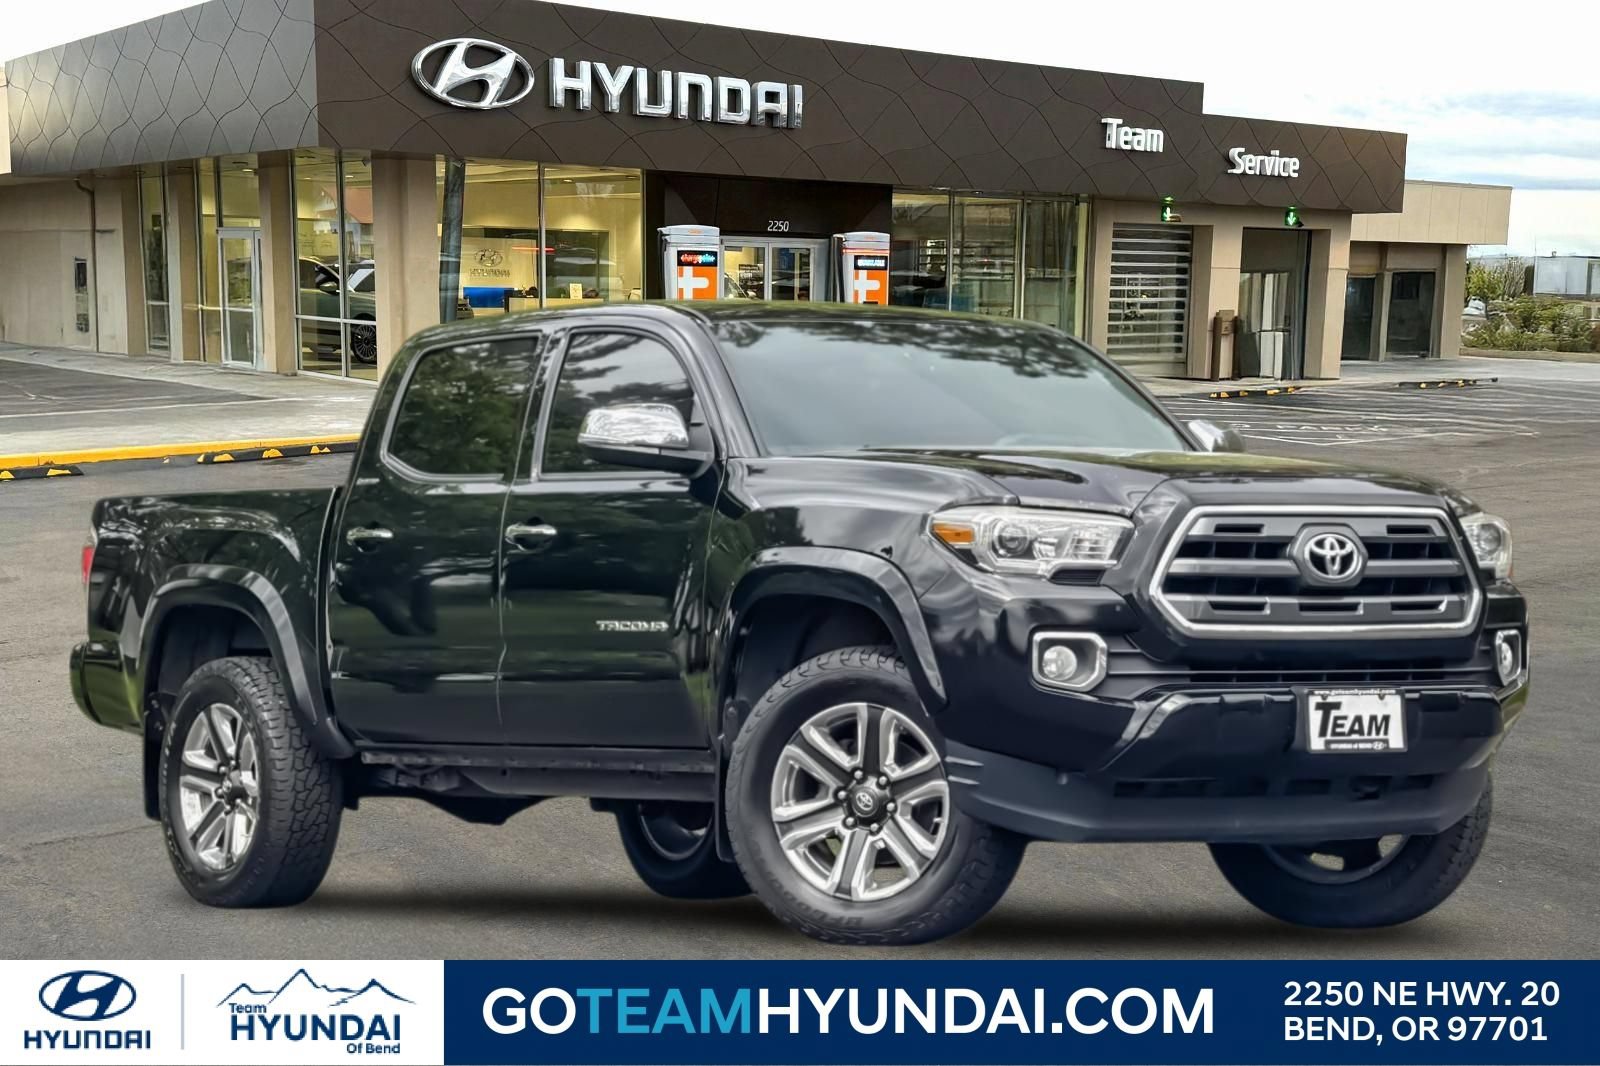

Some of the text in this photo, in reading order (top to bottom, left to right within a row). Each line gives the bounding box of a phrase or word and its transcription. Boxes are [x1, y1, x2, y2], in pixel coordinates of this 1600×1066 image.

[548, 56, 803, 130] HYUNDAI
[1101, 117, 1164, 153] Team
[1227, 147, 1300, 178] Service
[767, 220, 790, 232] 2250
[595, 620, 669, 632] TACOMA
[1314, 701, 1391, 738] TEAM
